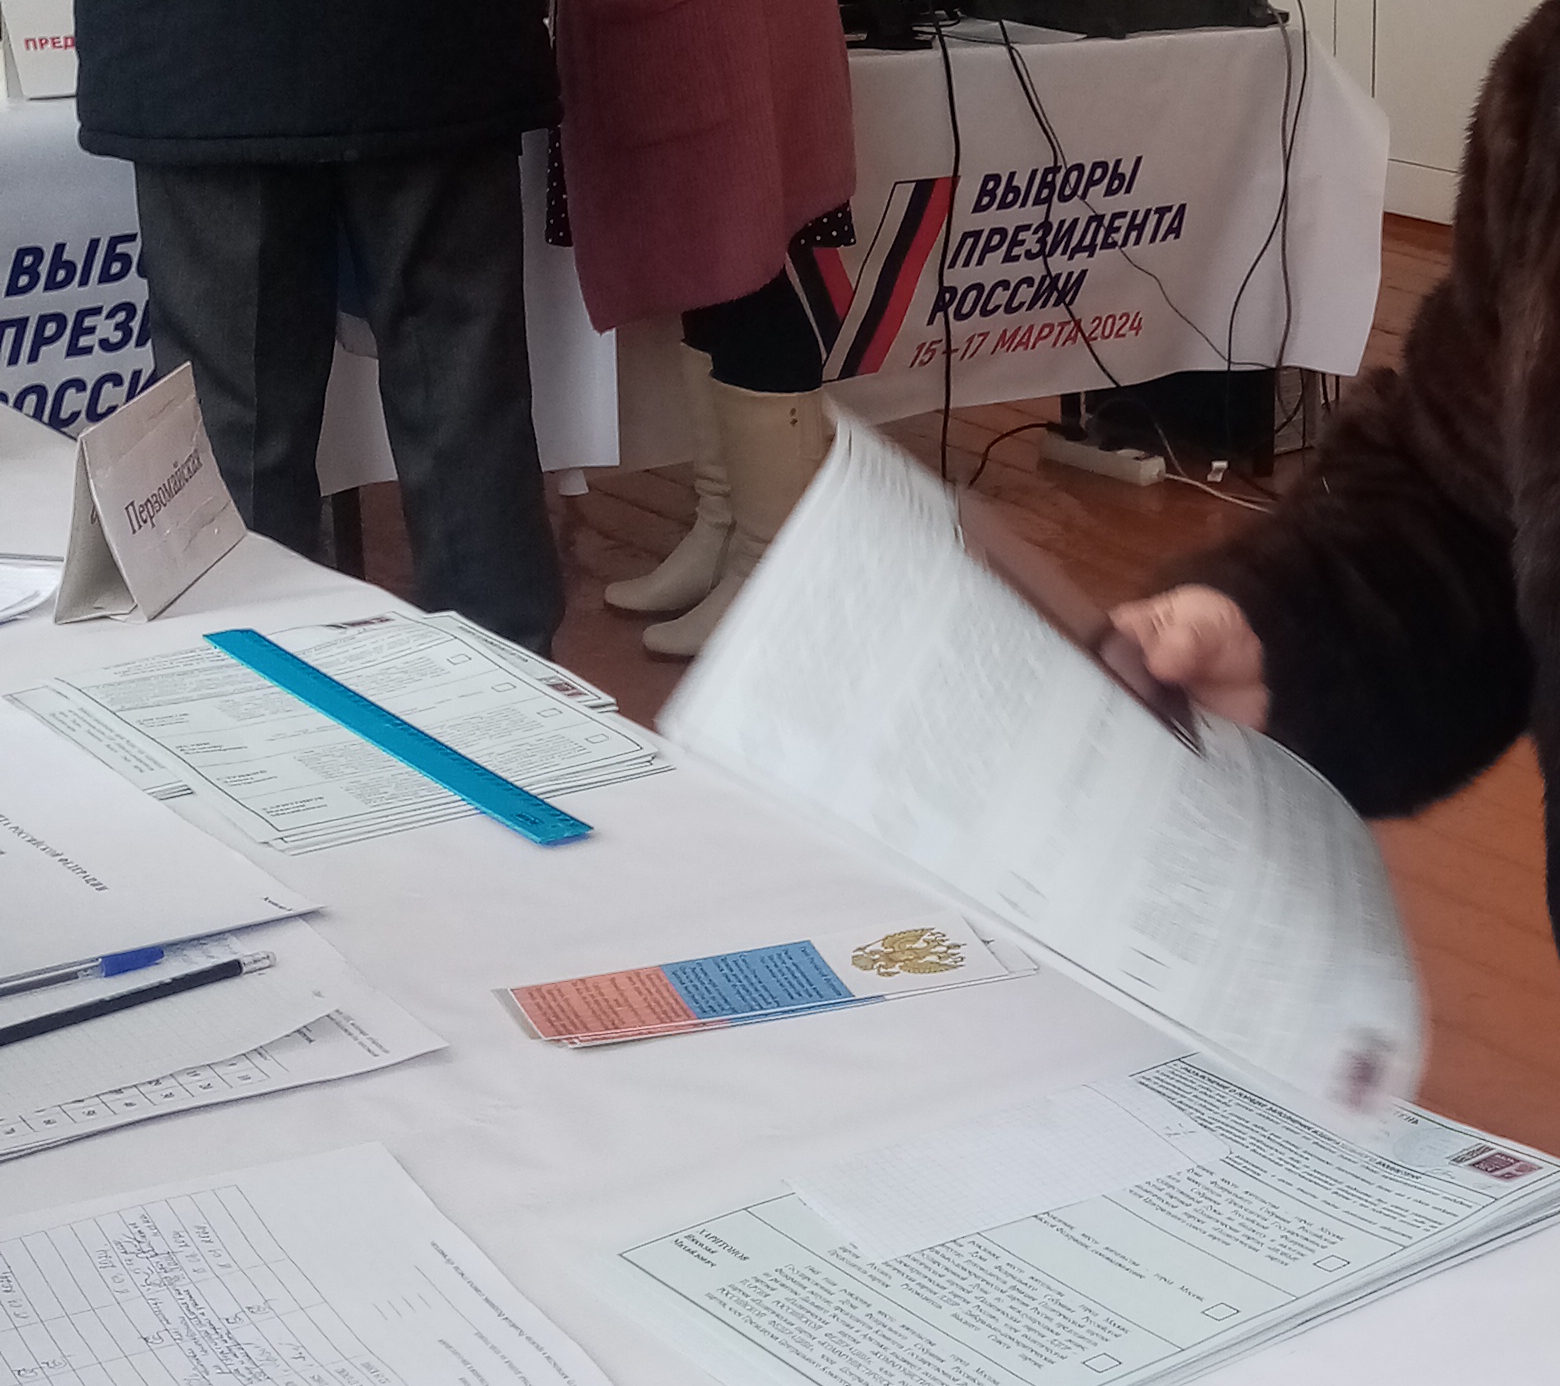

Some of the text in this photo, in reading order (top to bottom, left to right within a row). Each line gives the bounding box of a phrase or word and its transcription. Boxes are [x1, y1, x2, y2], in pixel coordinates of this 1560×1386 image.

[971, 155, 1144, 215] ВЫБОРЫ
[4, 232, 141, 299] ВЫБ
[947, 203, 1188, 271] ПРЕЗИДЕНТА
[927, 269, 1087, 326] РОССИИ
[995, 321, 1083, 354] МАРТА
[1085, 311, 1144, 343] 2024
